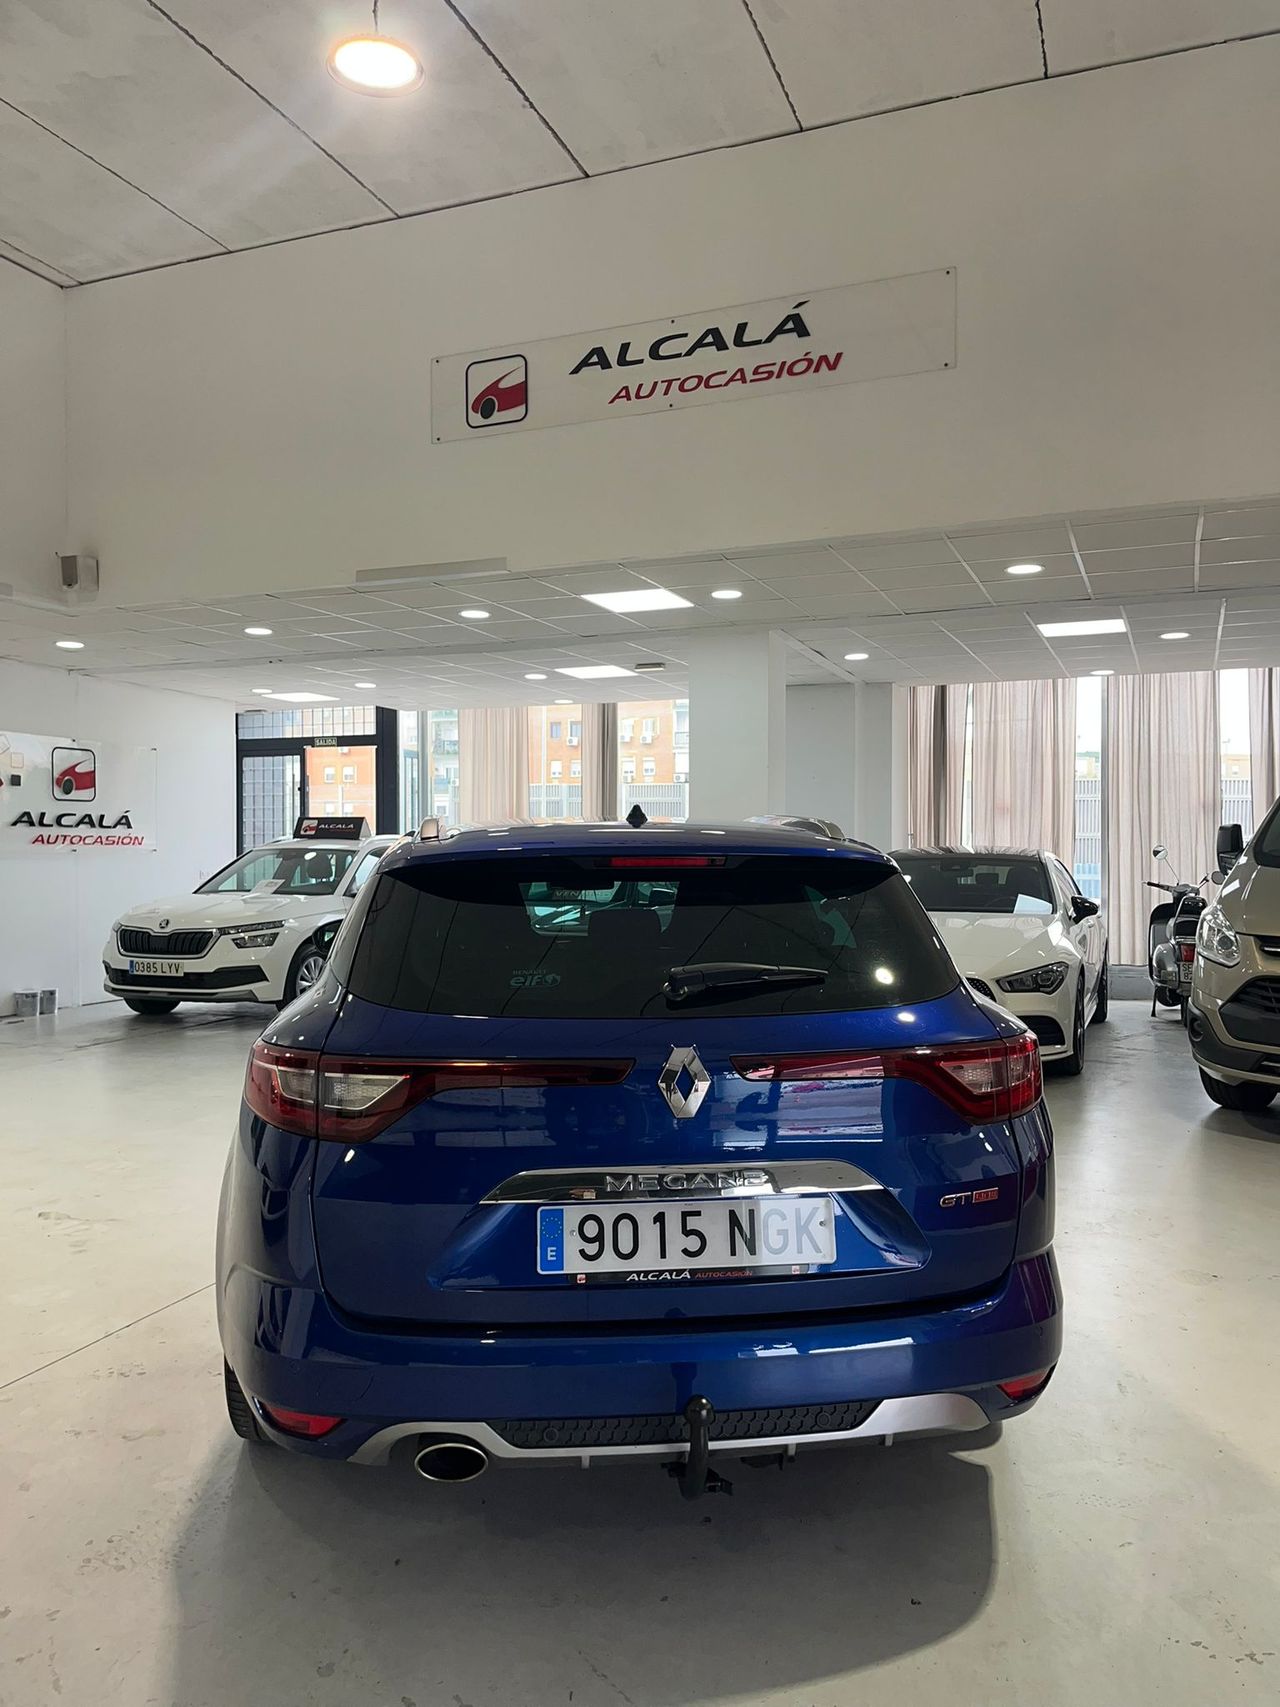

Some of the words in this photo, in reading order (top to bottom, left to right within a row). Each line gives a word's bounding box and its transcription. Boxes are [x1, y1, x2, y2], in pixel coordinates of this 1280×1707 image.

[569, 300, 811, 375] ALCALÁ
[608, 351, 843, 405] AUTOCASIÓN
[11, 810, 133, 830] ALCALÁ
[31, 833, 145, 847] AUTOCASIÓN
[135, 961, 158, 974] 0385
[160, 963, 181, 974] LYV
[510, 975, 543, 988] elf
[606, 1170, 770, 1192] MEGANE
[940, 1192, 972, 1207] GT
[547, 1247, 557, 1261] E
[577, 1210, 708, 1262] 9015
[728, 1206, 823, 1257] NGK
[626, 1268, 691, 1281] ALCALÁ
